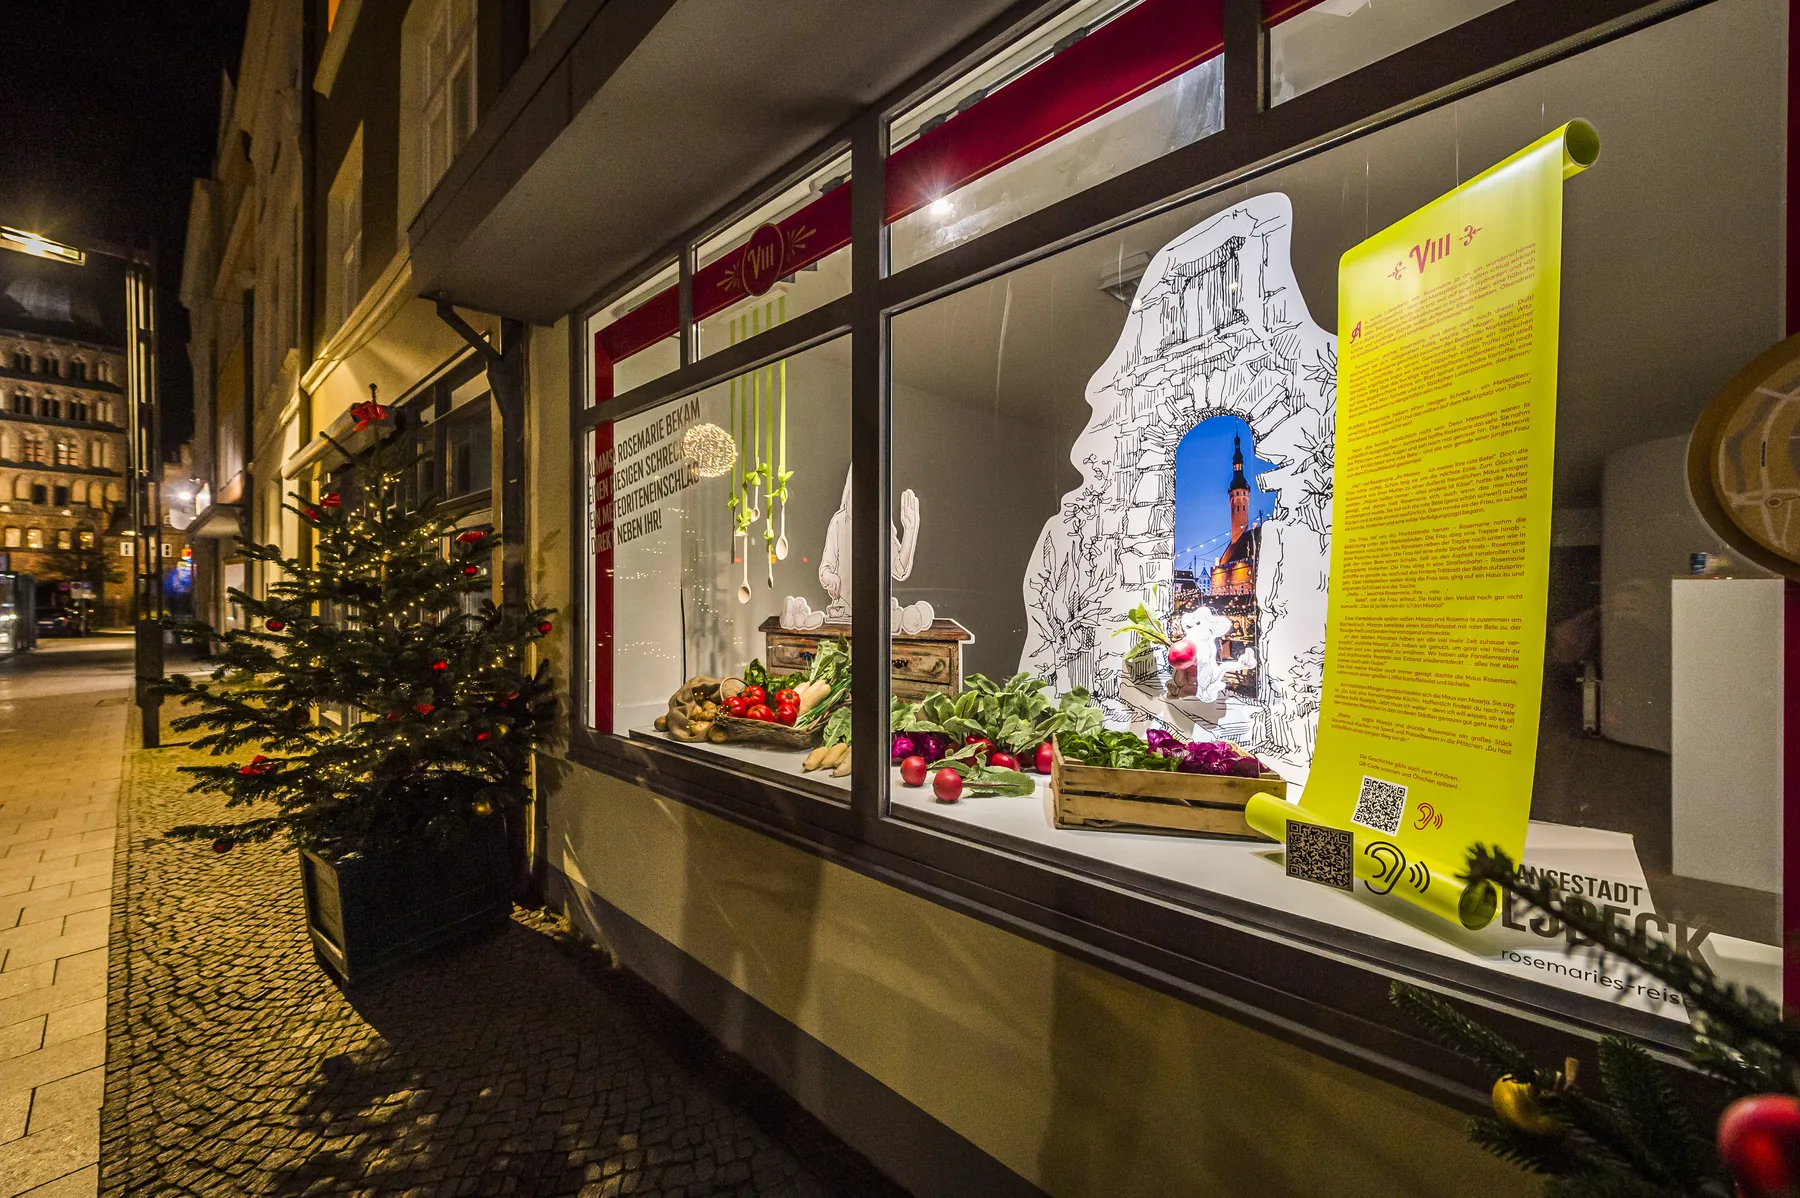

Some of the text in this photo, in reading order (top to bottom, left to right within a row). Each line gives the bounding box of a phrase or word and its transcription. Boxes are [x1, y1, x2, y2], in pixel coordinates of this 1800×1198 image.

[748, 243, 774, 280] VIII
[1409, 233, 1451, 274] VIII
[1470, 250, 1535, 281] Tallinn schlug wirklich
[1486, 243, 1535, 267] wunderschönes
[1475, 257, 1535, 286] Hydranten und sah
[1500, 273, 1535, 290] Obendrein
[1449, 266, 1535, 305] bunten eine hübsche
[1477, 294, 1534, 320] noch dieser Duft!
[1499, 311, 1513, 319] Kein
[1454, 311, 1533, 343] Beinen Marktbesucher
[1460, 319, 1533, 348] stibitzte Stückchen
[1460, 325, 1533, 354] echten Trüffel und stieß
[1466, 333, 1532, 359] außerdem auch noch
[1470, 357, 1486, 365] halbe
[1518, 341, 1532, 349] eine
[1508, 350, 1532, 361] jeman-
[1450, 373, 1531, 399] Schreck Meteoriten-
[1462, 390, 1494, 402] Marktplatz
[1508, 378, 1531, 389] Tallinn!
[1466, 411, 1497, 422] Meteoriten
[1501, 405, 1520, 413] waren
[1510, 410, 1530, 418] nahm
[617, 418, 664, 463] ROSEMARIE
[666, 397, 700, 436] BEKAM
[1453, 417, 1530, 441] genauer Meteorit
[1454, 438, 1474, 448] gerade
[1491, 429, 1512, 439] jungen
[1495, 458, 1513, 466] Glück
[1500, 450, 1517, 458] Doch
[588, 480, 609, 505] EINEN
[610, 458, 644, 494] RIESIGEN
[1447, 472, 1481, 482] freundlichen
[1501, 464, 1528, 472] erzogen
[1493, 478, 1527, 488] manchmal
[1504, 493, 1527, 502] schnell
[590, 507, 601, 531] EIN
[616, 517, 643, 545] NEBEN
[644, 508, 662, 535] IHR!
[1419, 510, 1461, 520] Verfolgungsjagd
[1470, 653, 1519, 661] Familienrezepte
[1483, 676, 1517, 685] Rosemarie,
[1422, 699, 1451, 707] Hoffentlich
[1468, 697, 1490, 705] Maarja.
[1406, 730, 1511, 755] Preiselbeeren hast
[1428, 728, 1456, 737] Rosemarie
[1495, 739, 1512, 747] Stück
[1359, 761, 1380, 770] QR-Code
[1381, 767, 1400, 775] scannen
[1412, 773, 1435, 783] Öhrchen
[1436, 781, 1458, 789] spitzen!
[1368, 756, 1393, 766] Geschichte
[1434, 771, 1458, 781] Anhören.
[1500, 949, 1684, 1006] rosemaries-reis
